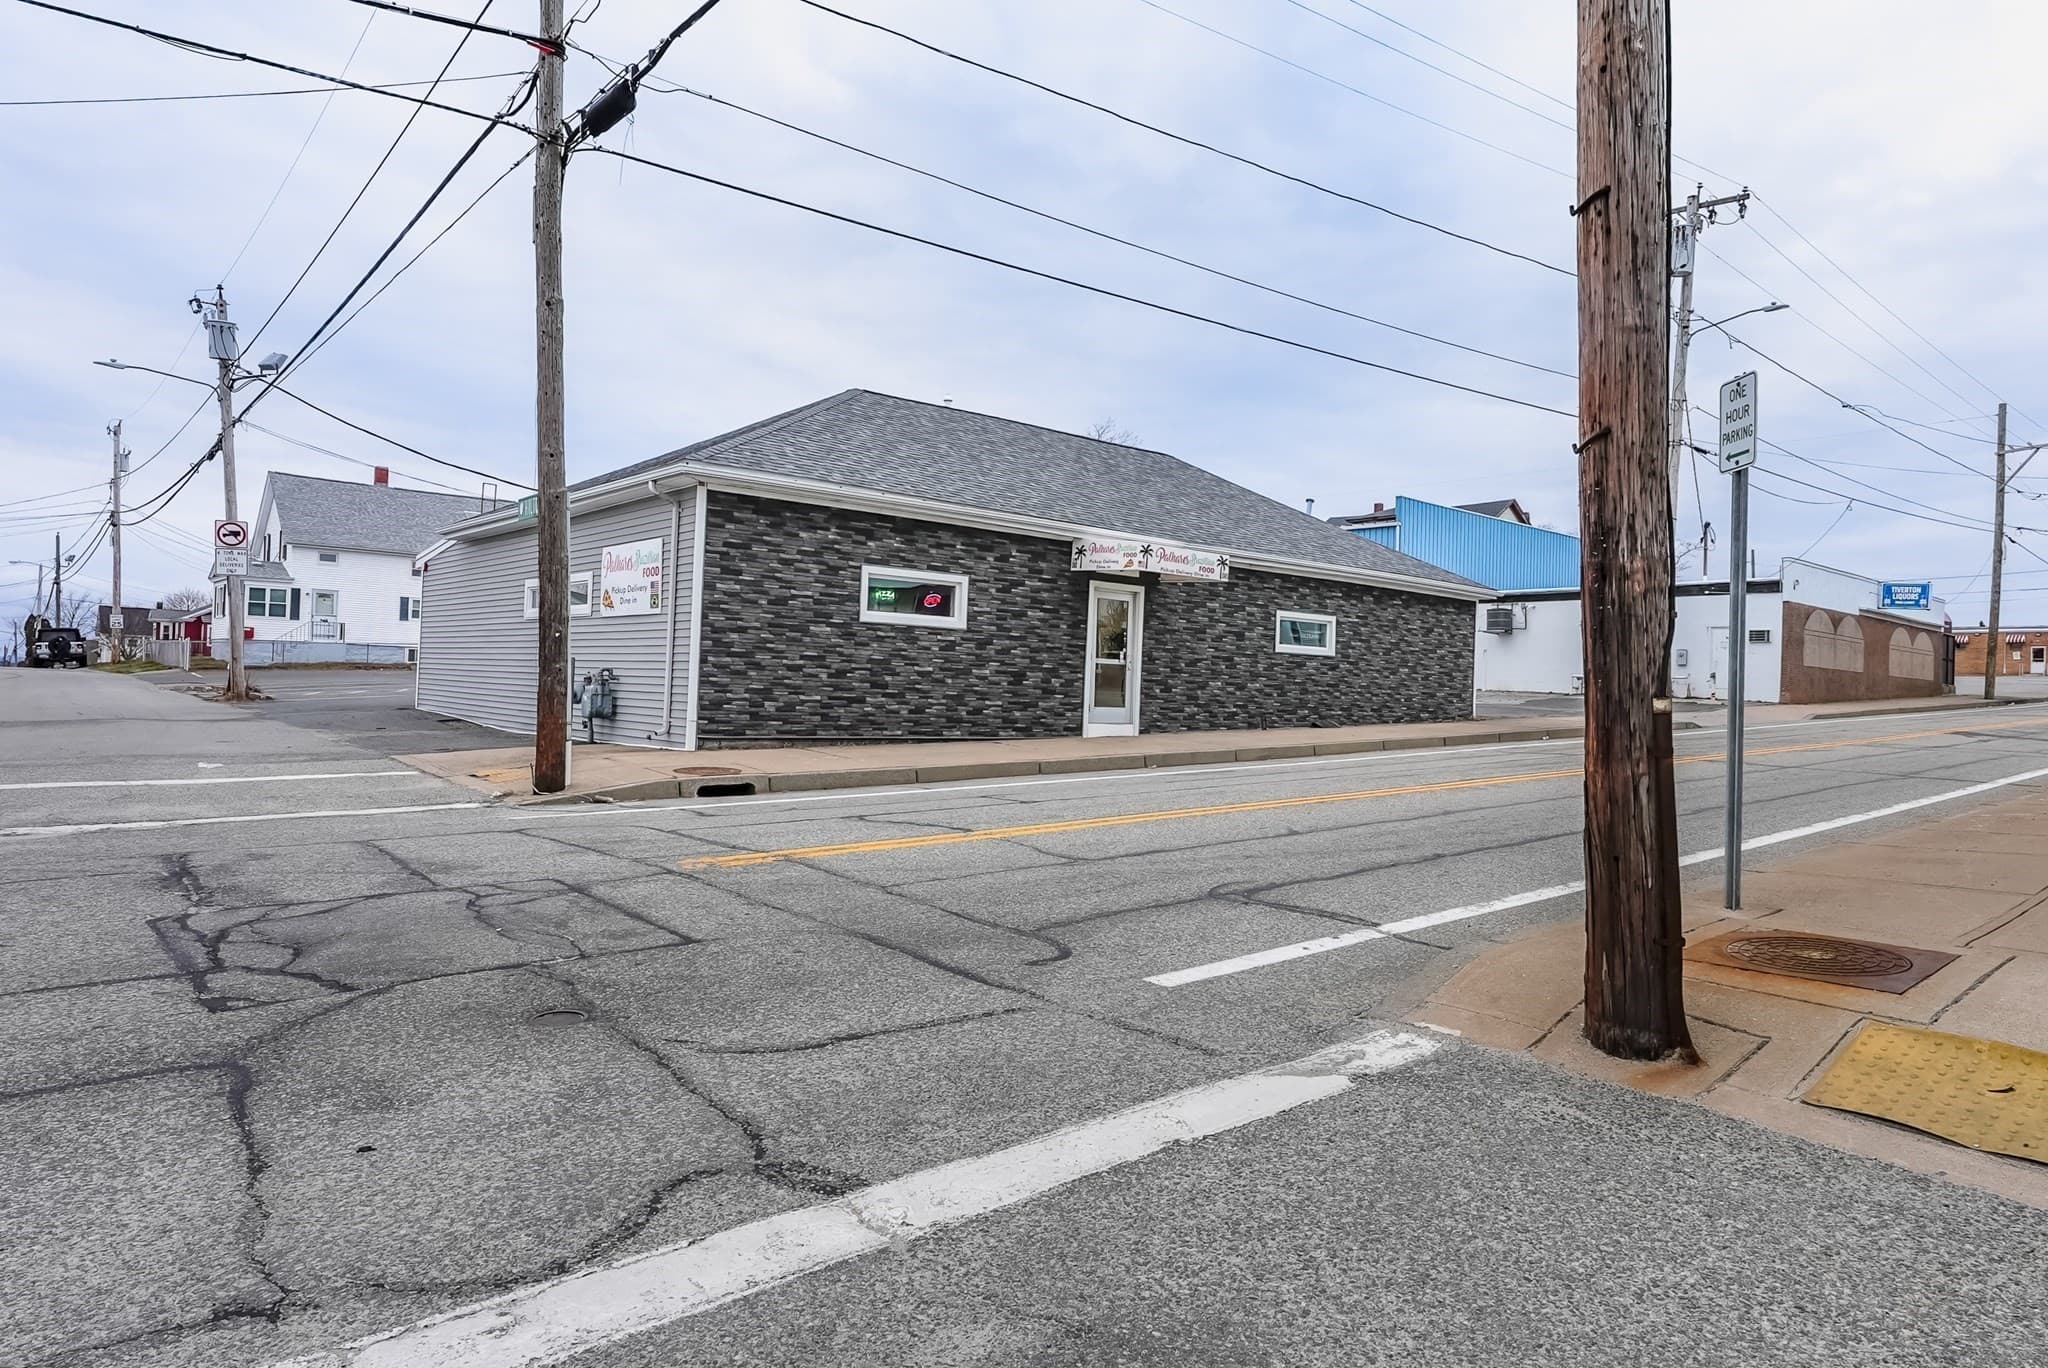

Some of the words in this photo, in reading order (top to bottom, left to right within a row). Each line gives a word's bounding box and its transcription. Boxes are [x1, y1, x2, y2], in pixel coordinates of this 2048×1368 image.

[1729, 384, 1748, 403] ONE
[1725, 403, 1751, 425] HOUR
[1721, 423, 1754, 447] PARKING
[642, 566, 660, 578] FOOD
[1199, 566, 1215, 574] FOOD
[611, 586, 627, 595] Pickup
[627, 584, 648, 593] Delivery
